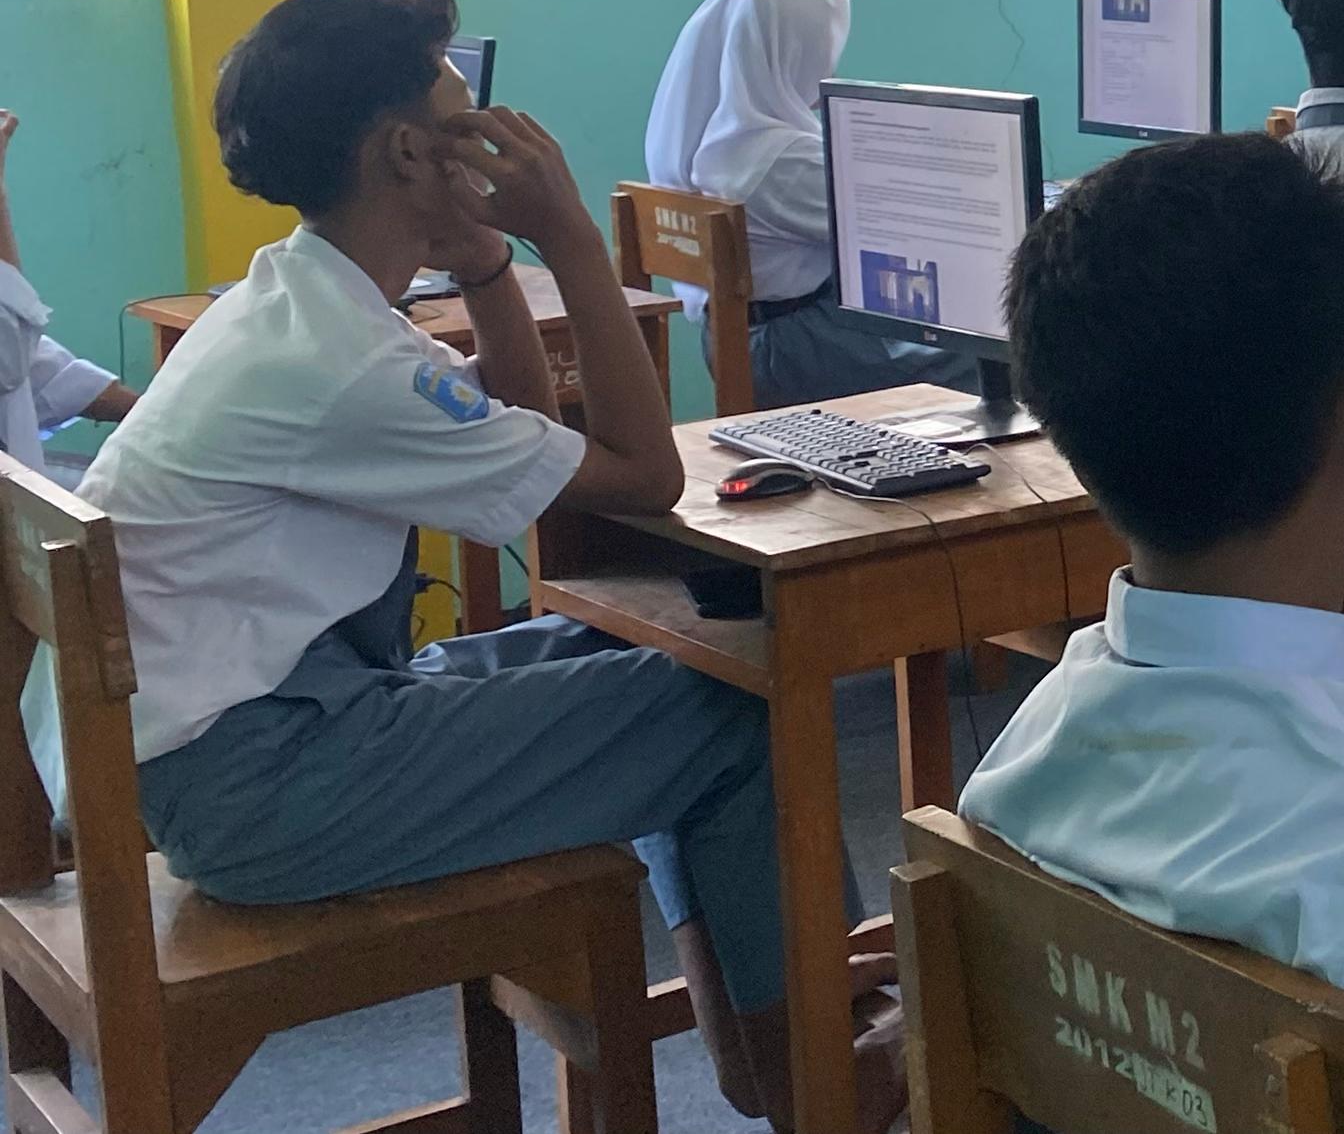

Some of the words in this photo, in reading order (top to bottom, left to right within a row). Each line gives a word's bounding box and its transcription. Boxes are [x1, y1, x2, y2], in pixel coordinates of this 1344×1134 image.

[1047, 942, 1133, 1034] SMK
[1145, 991, 1206, 1071] M2
[1056, 1015, 1134, 1080] 2012
